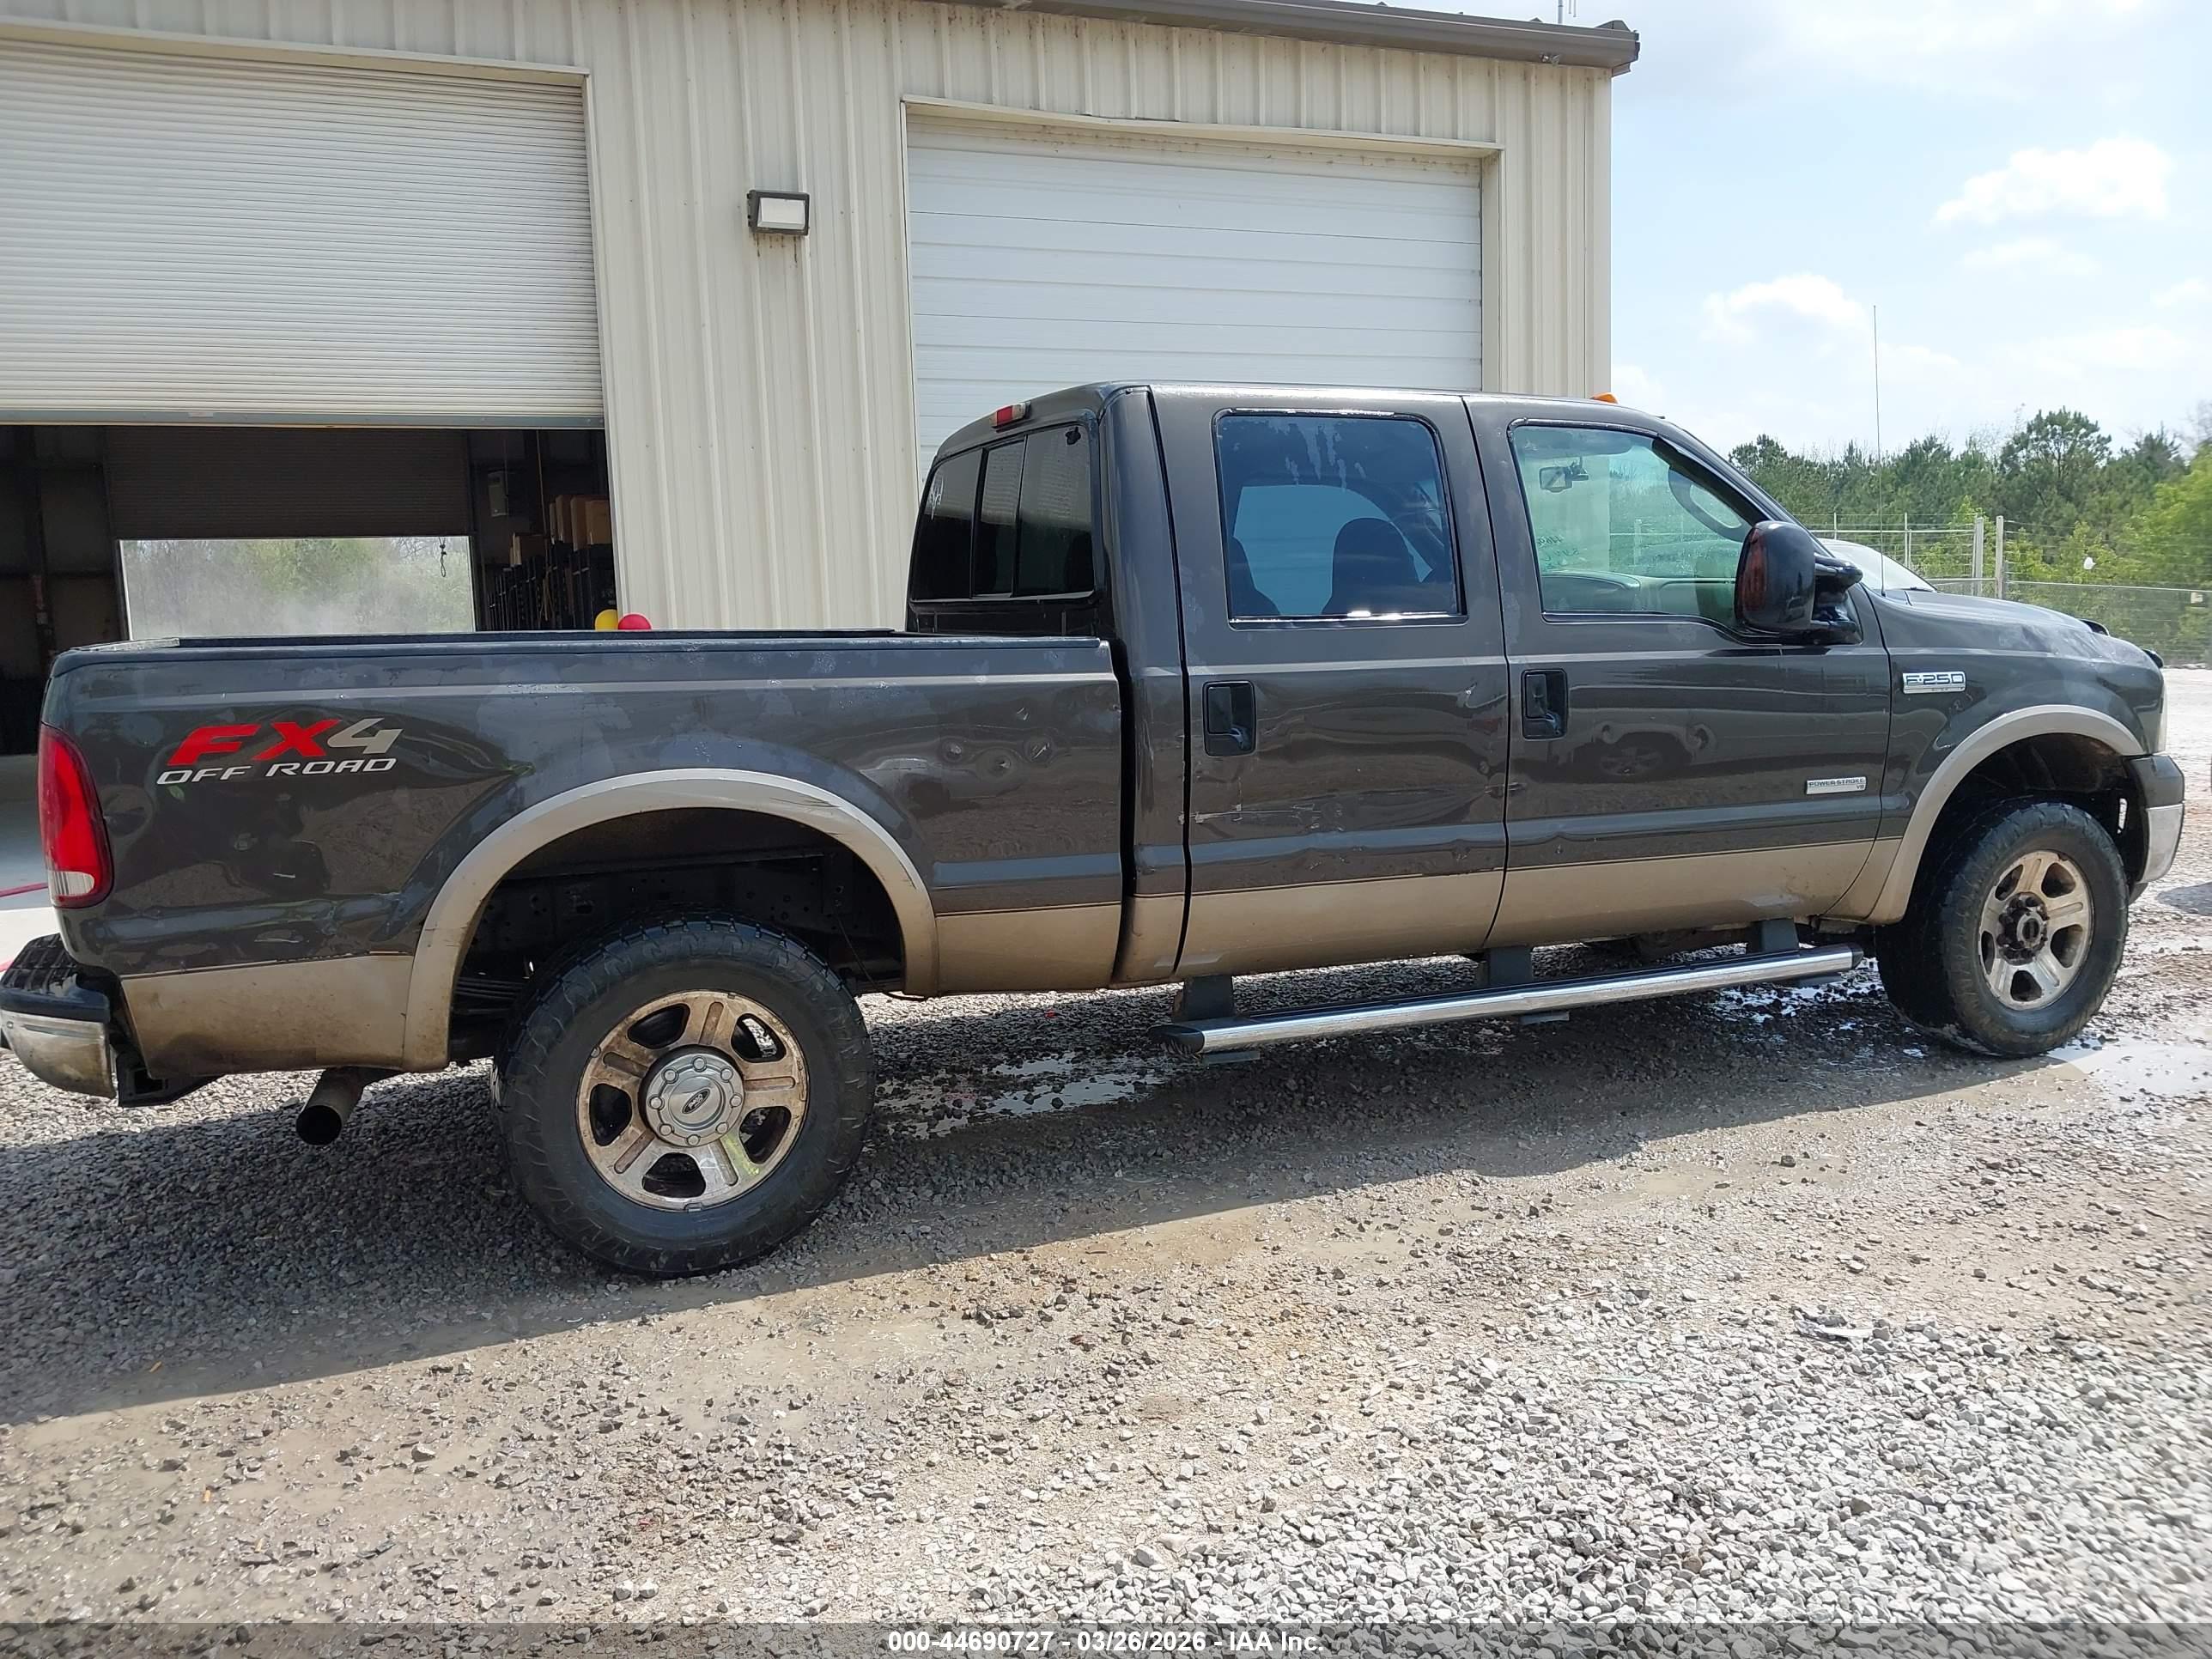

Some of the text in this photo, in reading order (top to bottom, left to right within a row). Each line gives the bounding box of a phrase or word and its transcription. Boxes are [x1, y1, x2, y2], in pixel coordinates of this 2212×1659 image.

[167, 718, 404, 766] FX4
[156, 758, 397, 785] OFF ROAD
